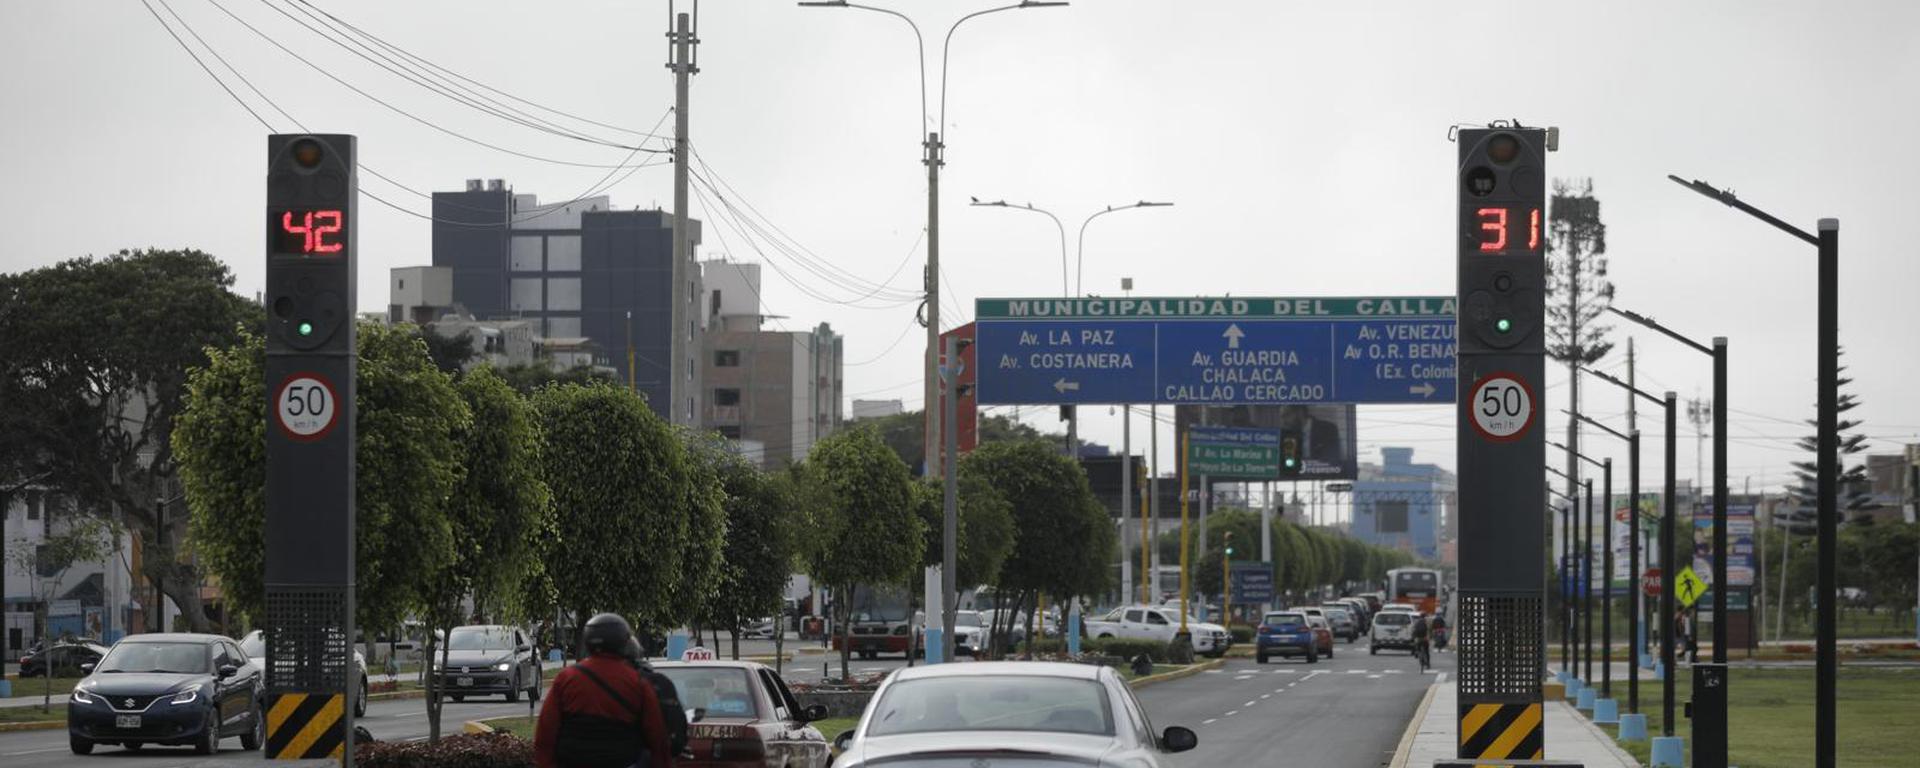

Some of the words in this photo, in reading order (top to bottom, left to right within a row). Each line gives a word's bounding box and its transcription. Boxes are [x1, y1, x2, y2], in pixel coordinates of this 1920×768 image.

[283, 210, 343, 253] 42
[1477, 207, 1539, 252] 31
[1009, 300, 1248, 315] MUNICIPALIDAD
[1274, 300, 1329, 314] DEL
[1356, 300, 1457, 314] CALLA
[1018, 330, 1040, 345] Av.
[1049, 331, 1072, 345] LA
[1081, 330, 1115, 345] PAZ
[1358, 325, 1380, 339] Av.
[1385, 325, 1457, 339] VENEZU
[1192, 352, 1213, 366] Av.
[1222, 351, 1299, 366] GUARDIA
[1369, 344, 1403, 359] O.R.
[1409, 344, 1457, 358] BENA
[999, 354, 1021, 369] Av.
[1030, 353, 1133, 368] COSTANERA
[1203, 368, 1286, 383] CHALACA
[1411, 364, 1457, 379] Coloni
[1166, 385, 1234, 401] CALLAO
[1244, 385, 1324, 400] CERCADO
[288, 386, 324, 416] 50
[1483, 386, 1521, 417] 50
[1641, 575, 1661, 586] PAR
[686, 651, 712, 661] TAXI
